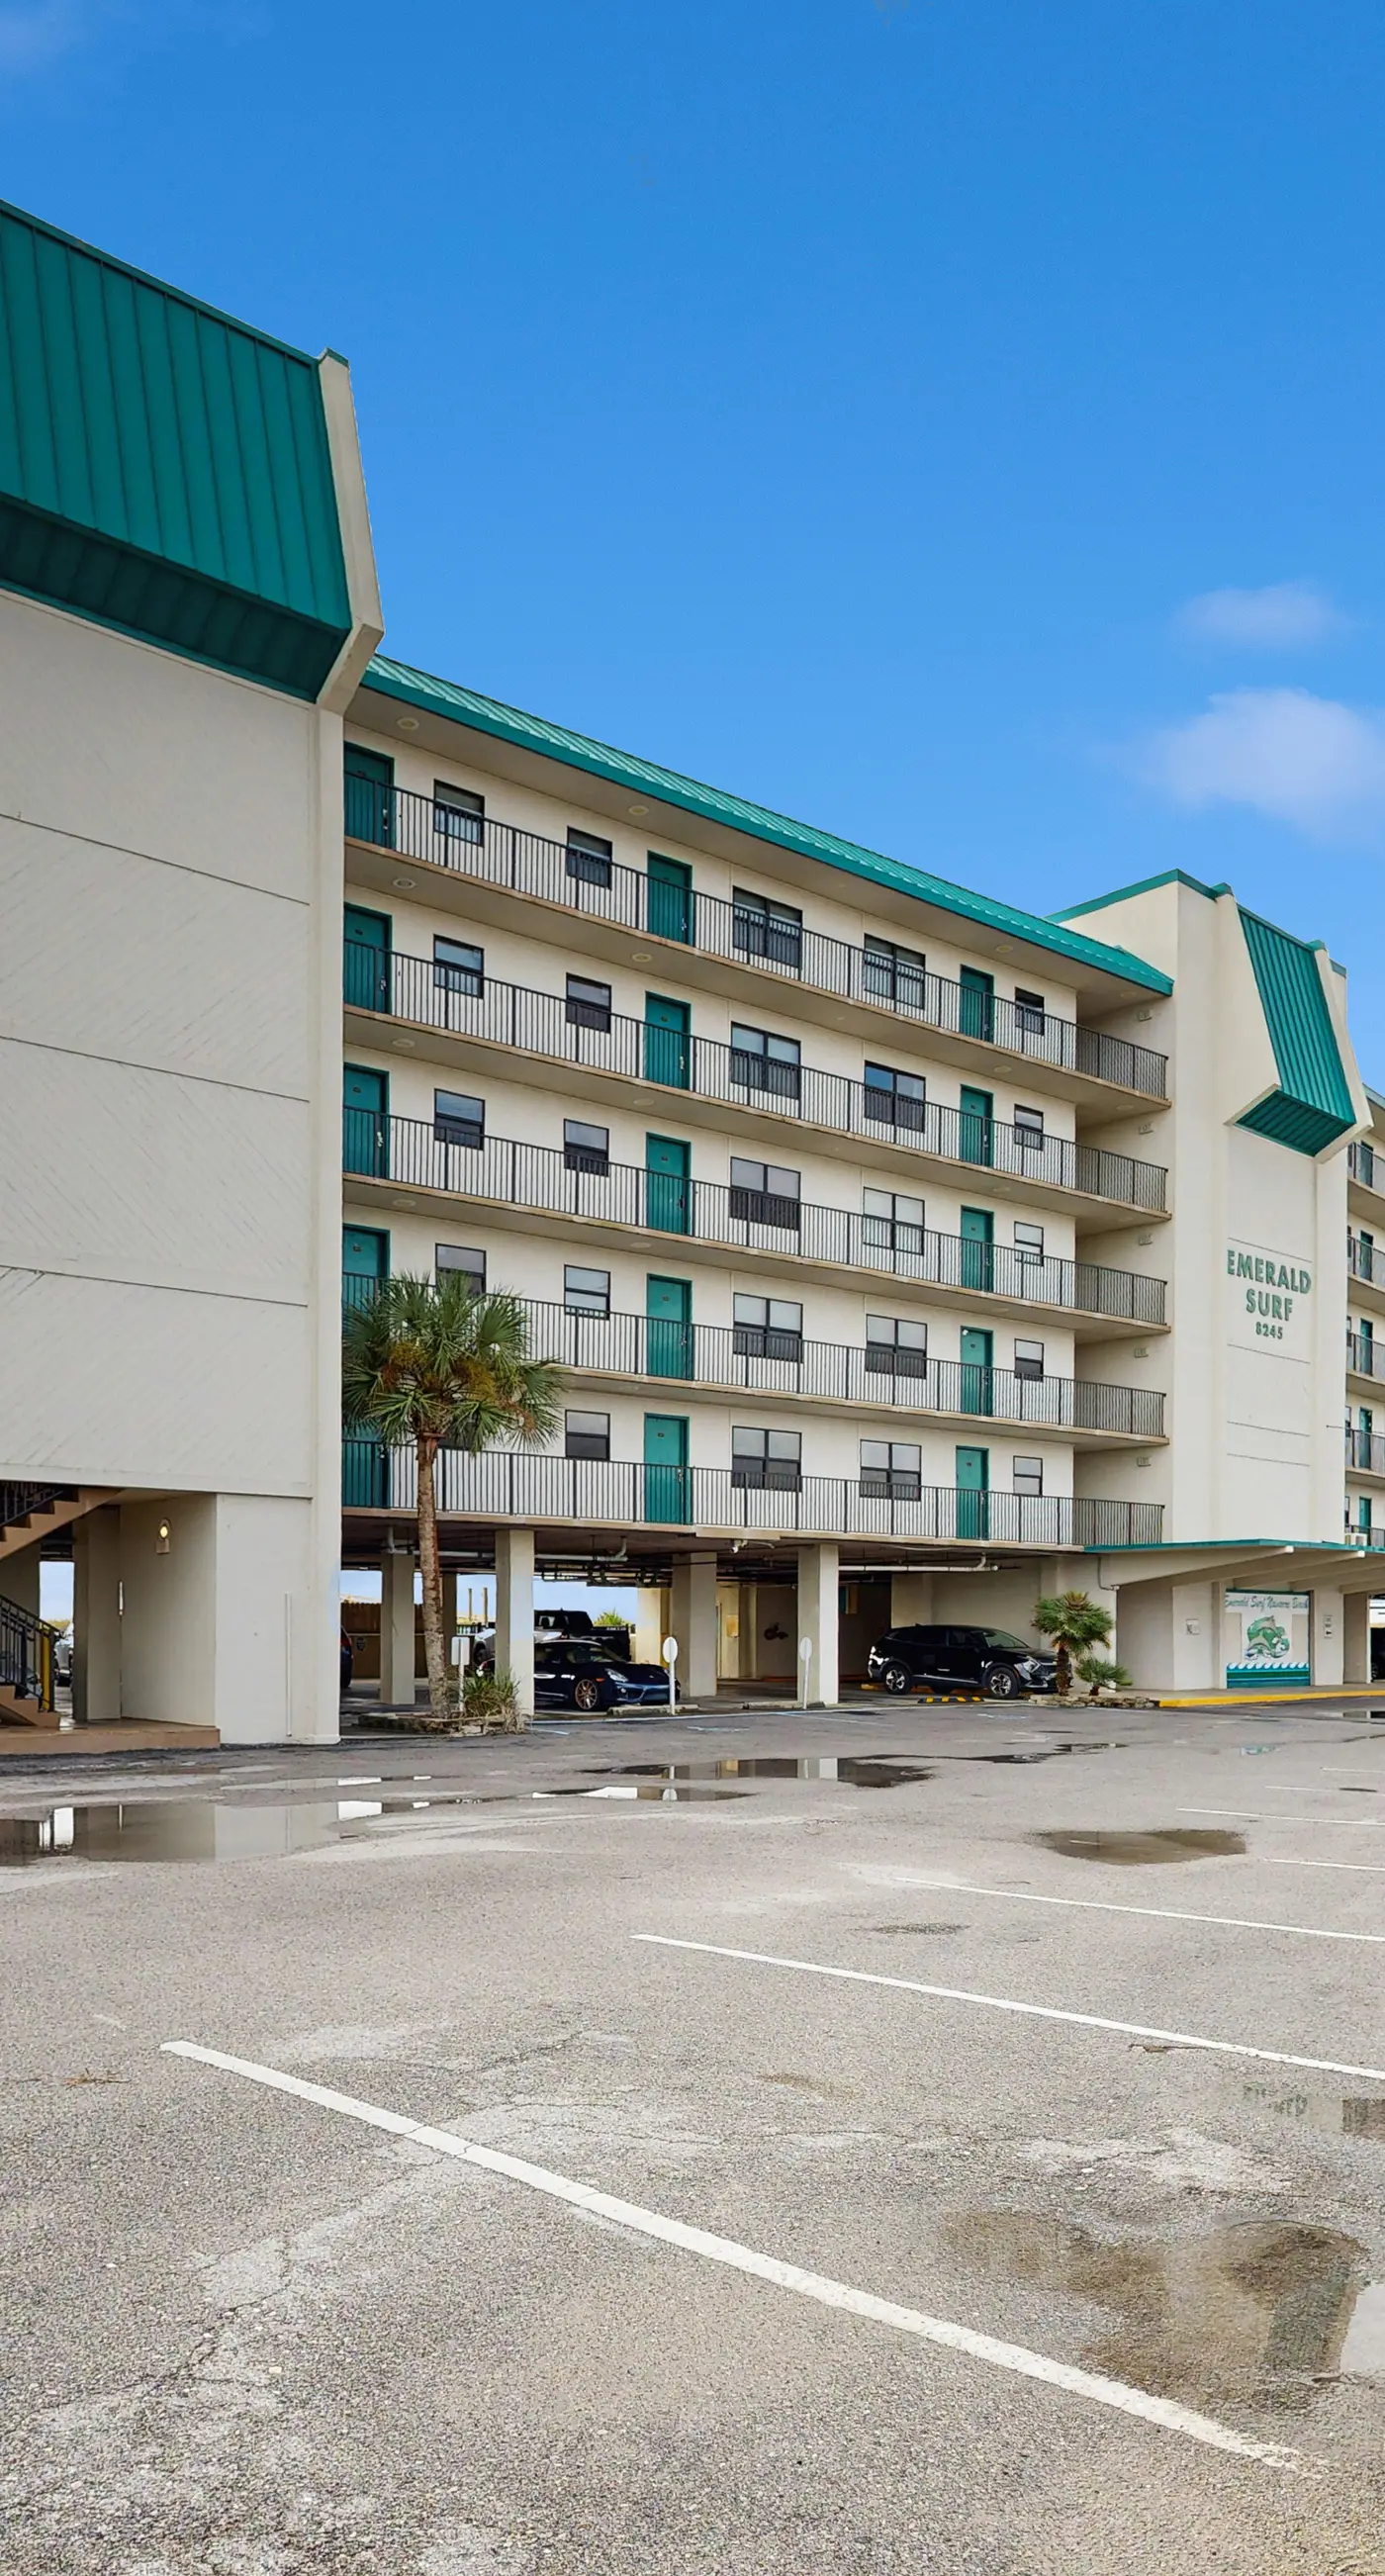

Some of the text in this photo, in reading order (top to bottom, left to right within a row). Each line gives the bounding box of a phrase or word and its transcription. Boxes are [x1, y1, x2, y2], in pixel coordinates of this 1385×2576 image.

[1227, 1249, 1312, 1294] EMERALD
[1246, 1288, 1293, 1322] SURF
[1255, 1322, 1283, 1339] 8245
